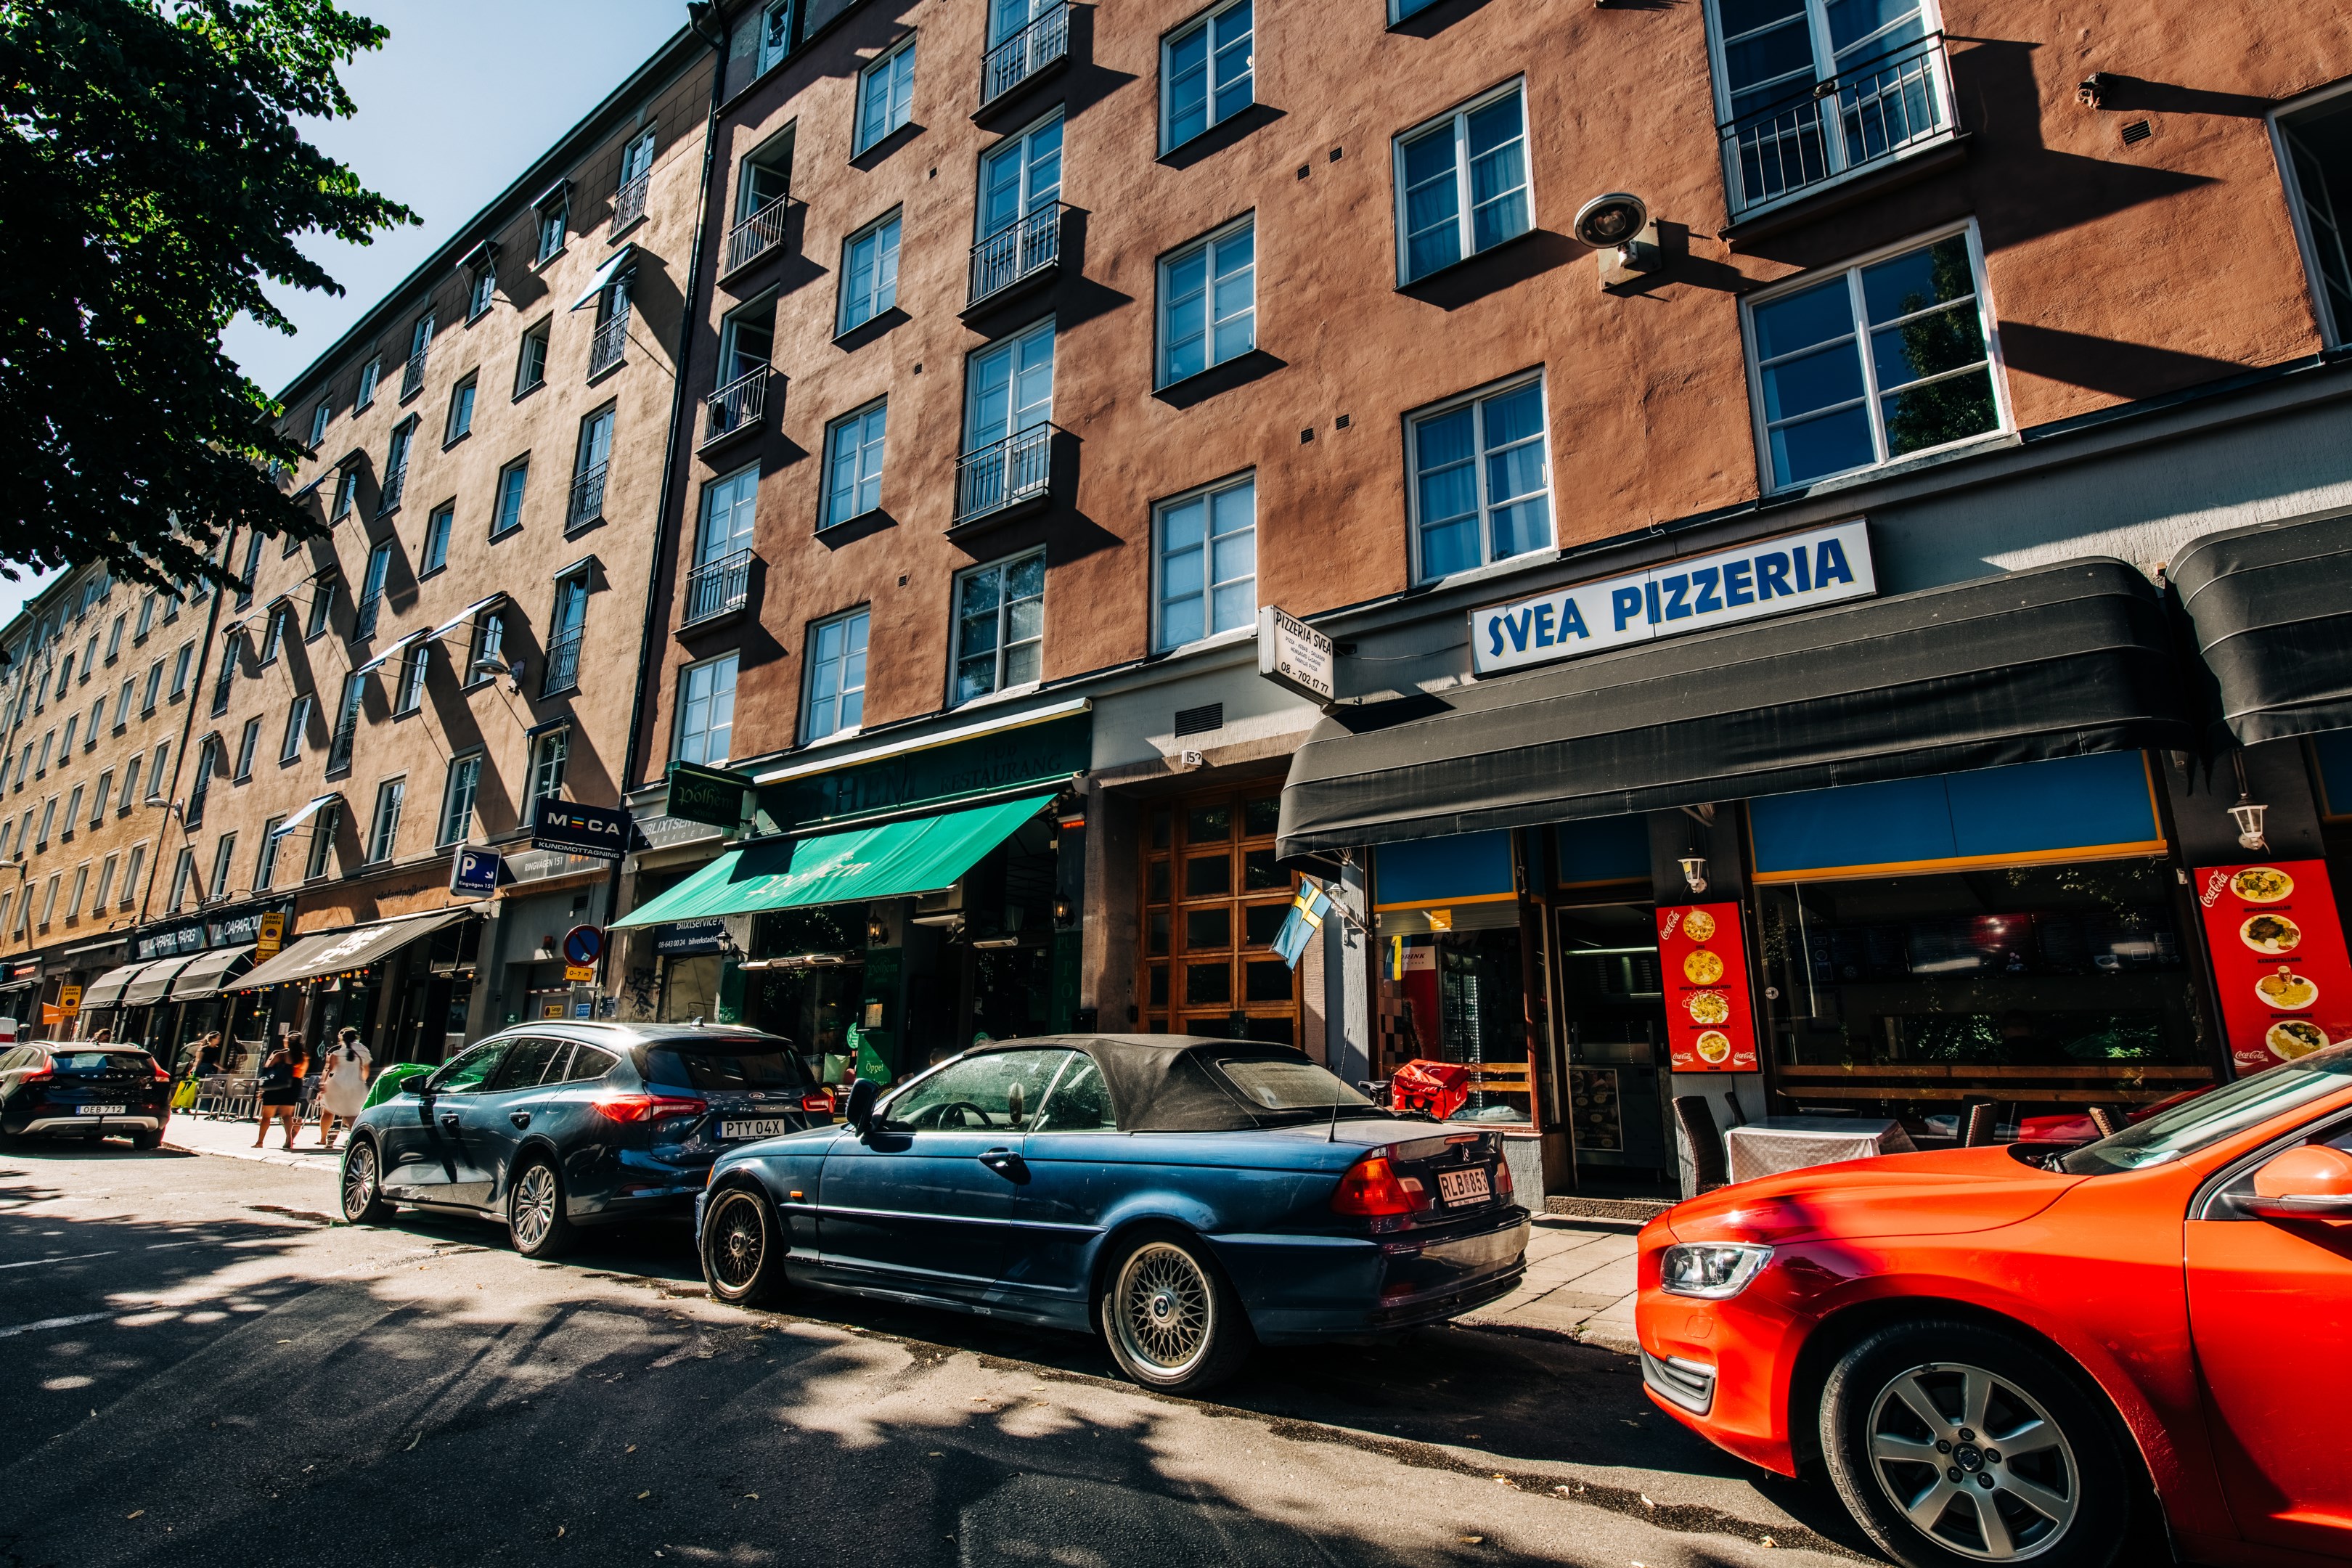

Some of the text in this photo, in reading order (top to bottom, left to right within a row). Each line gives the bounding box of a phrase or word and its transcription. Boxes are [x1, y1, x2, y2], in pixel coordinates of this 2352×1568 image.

[1489, 539, 1855, 657] SVEA PIZZERIA
[1276, 612, 1331, 656] PIZZERIA SVEA
[1285, 637, 1295, 645] PIZZA
[1298, 643, 1308, 653] KEBAB
[1309, 663, 1318, 671] PIZZA
[1281, 662, 1291, 674] 08
[1299, 670, 1311, 685] 702
[1312, 679, 1320, 688] 17
[1321, 682, 1329, 693] 77
[939, 753, 1062, 794] RESTAURANG
[678, 786, 735, 810] Polhem
[645, 828, 704, 846] GARAGET
[539, 841, 620, 859] KUNDMOTTAGNING
[461, 857, 476, 876] P
[524, 857, 563, 872] RINGVÄGEN 151
[458, 880, 483, 889] Ringvägen
[2199, 869, 2231, 908] Coca-Cola
[224, 916, 258, 936] CAPAROL
[150, 927, 196, 950] CAPAROL FÄRG
[727, 1120, 780, 1136] PTY 04X
[1440, 1170, 1488, 1198] RLB 853
